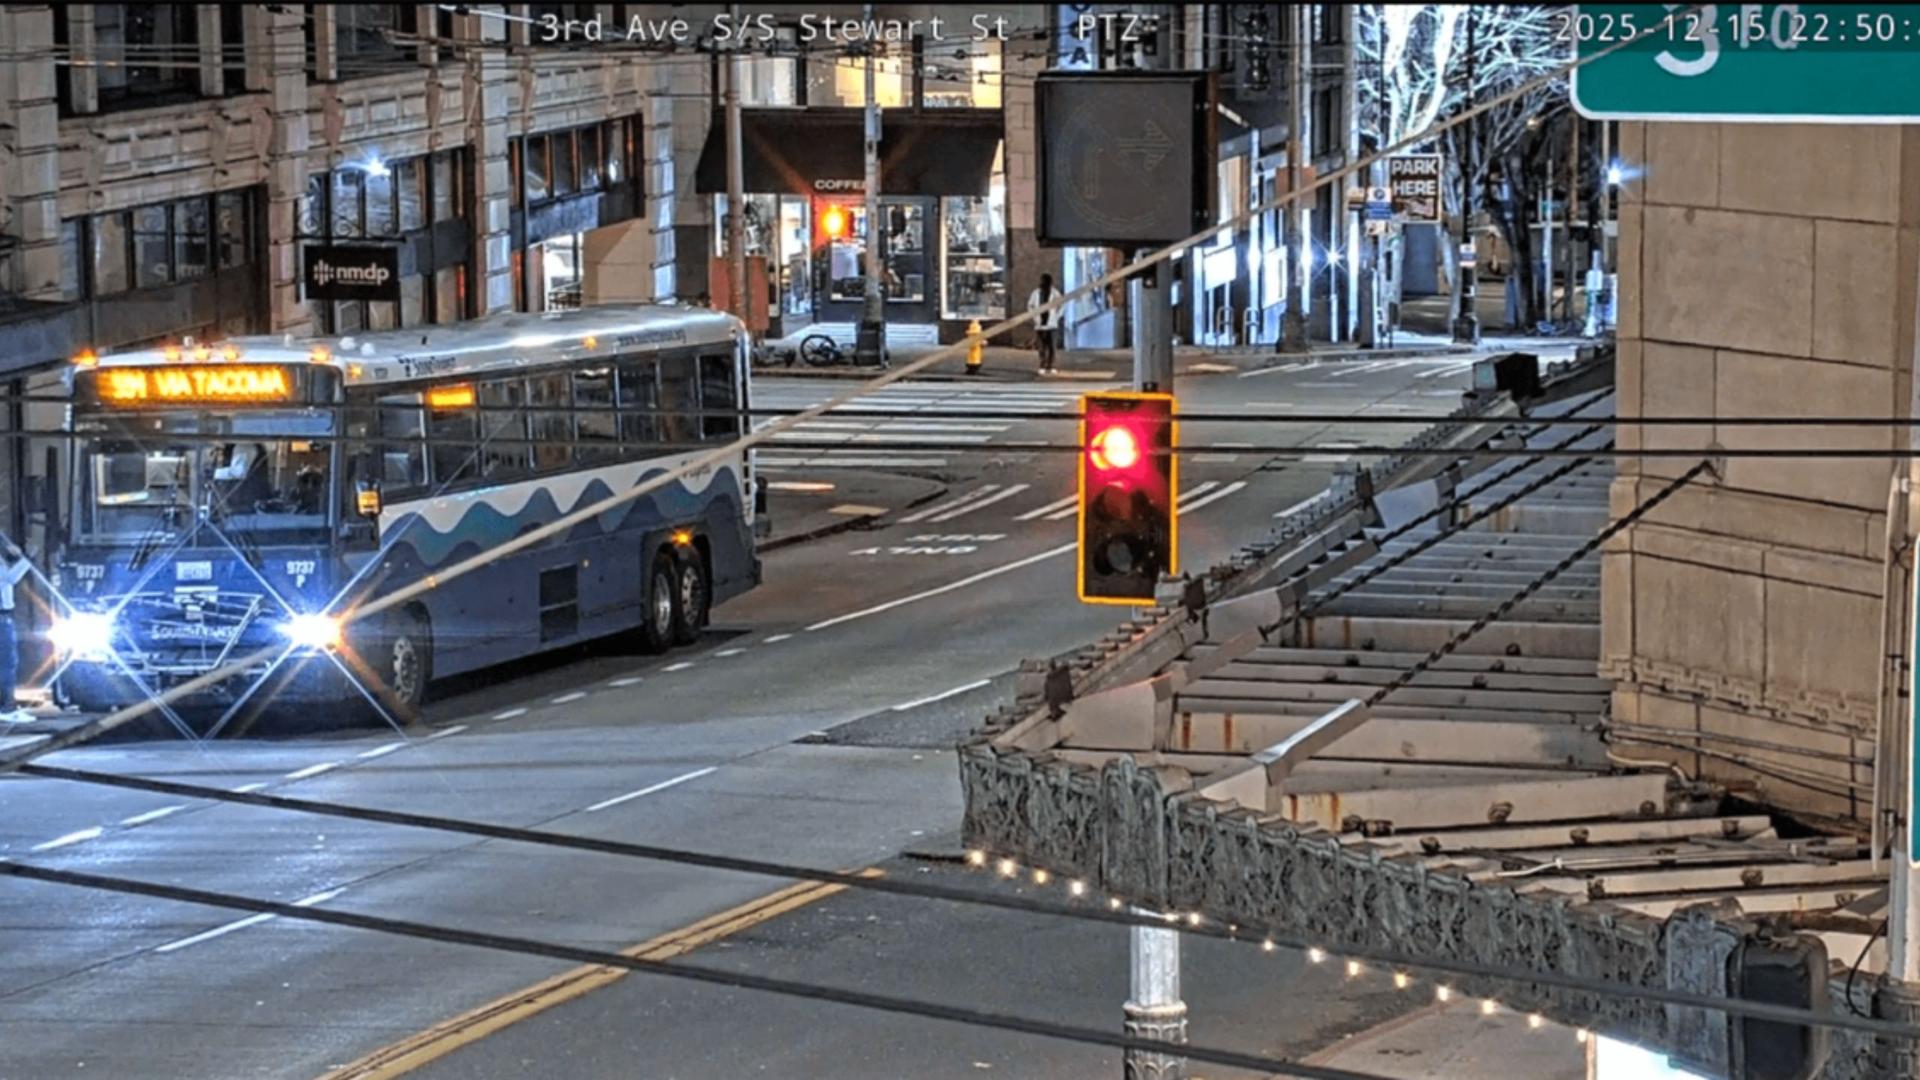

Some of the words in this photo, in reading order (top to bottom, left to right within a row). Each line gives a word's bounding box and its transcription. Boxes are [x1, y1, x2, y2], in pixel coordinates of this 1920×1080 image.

[1392, 160, 1437, 174] PARK
[1394, 181, 1436, 195] HERE
[336, 262, 389, 286] nmdp
[192, 368, 288, 396] TACOMA
[76, 565, 105, 579] 9737
[287, 560, 315, 574] 9737
